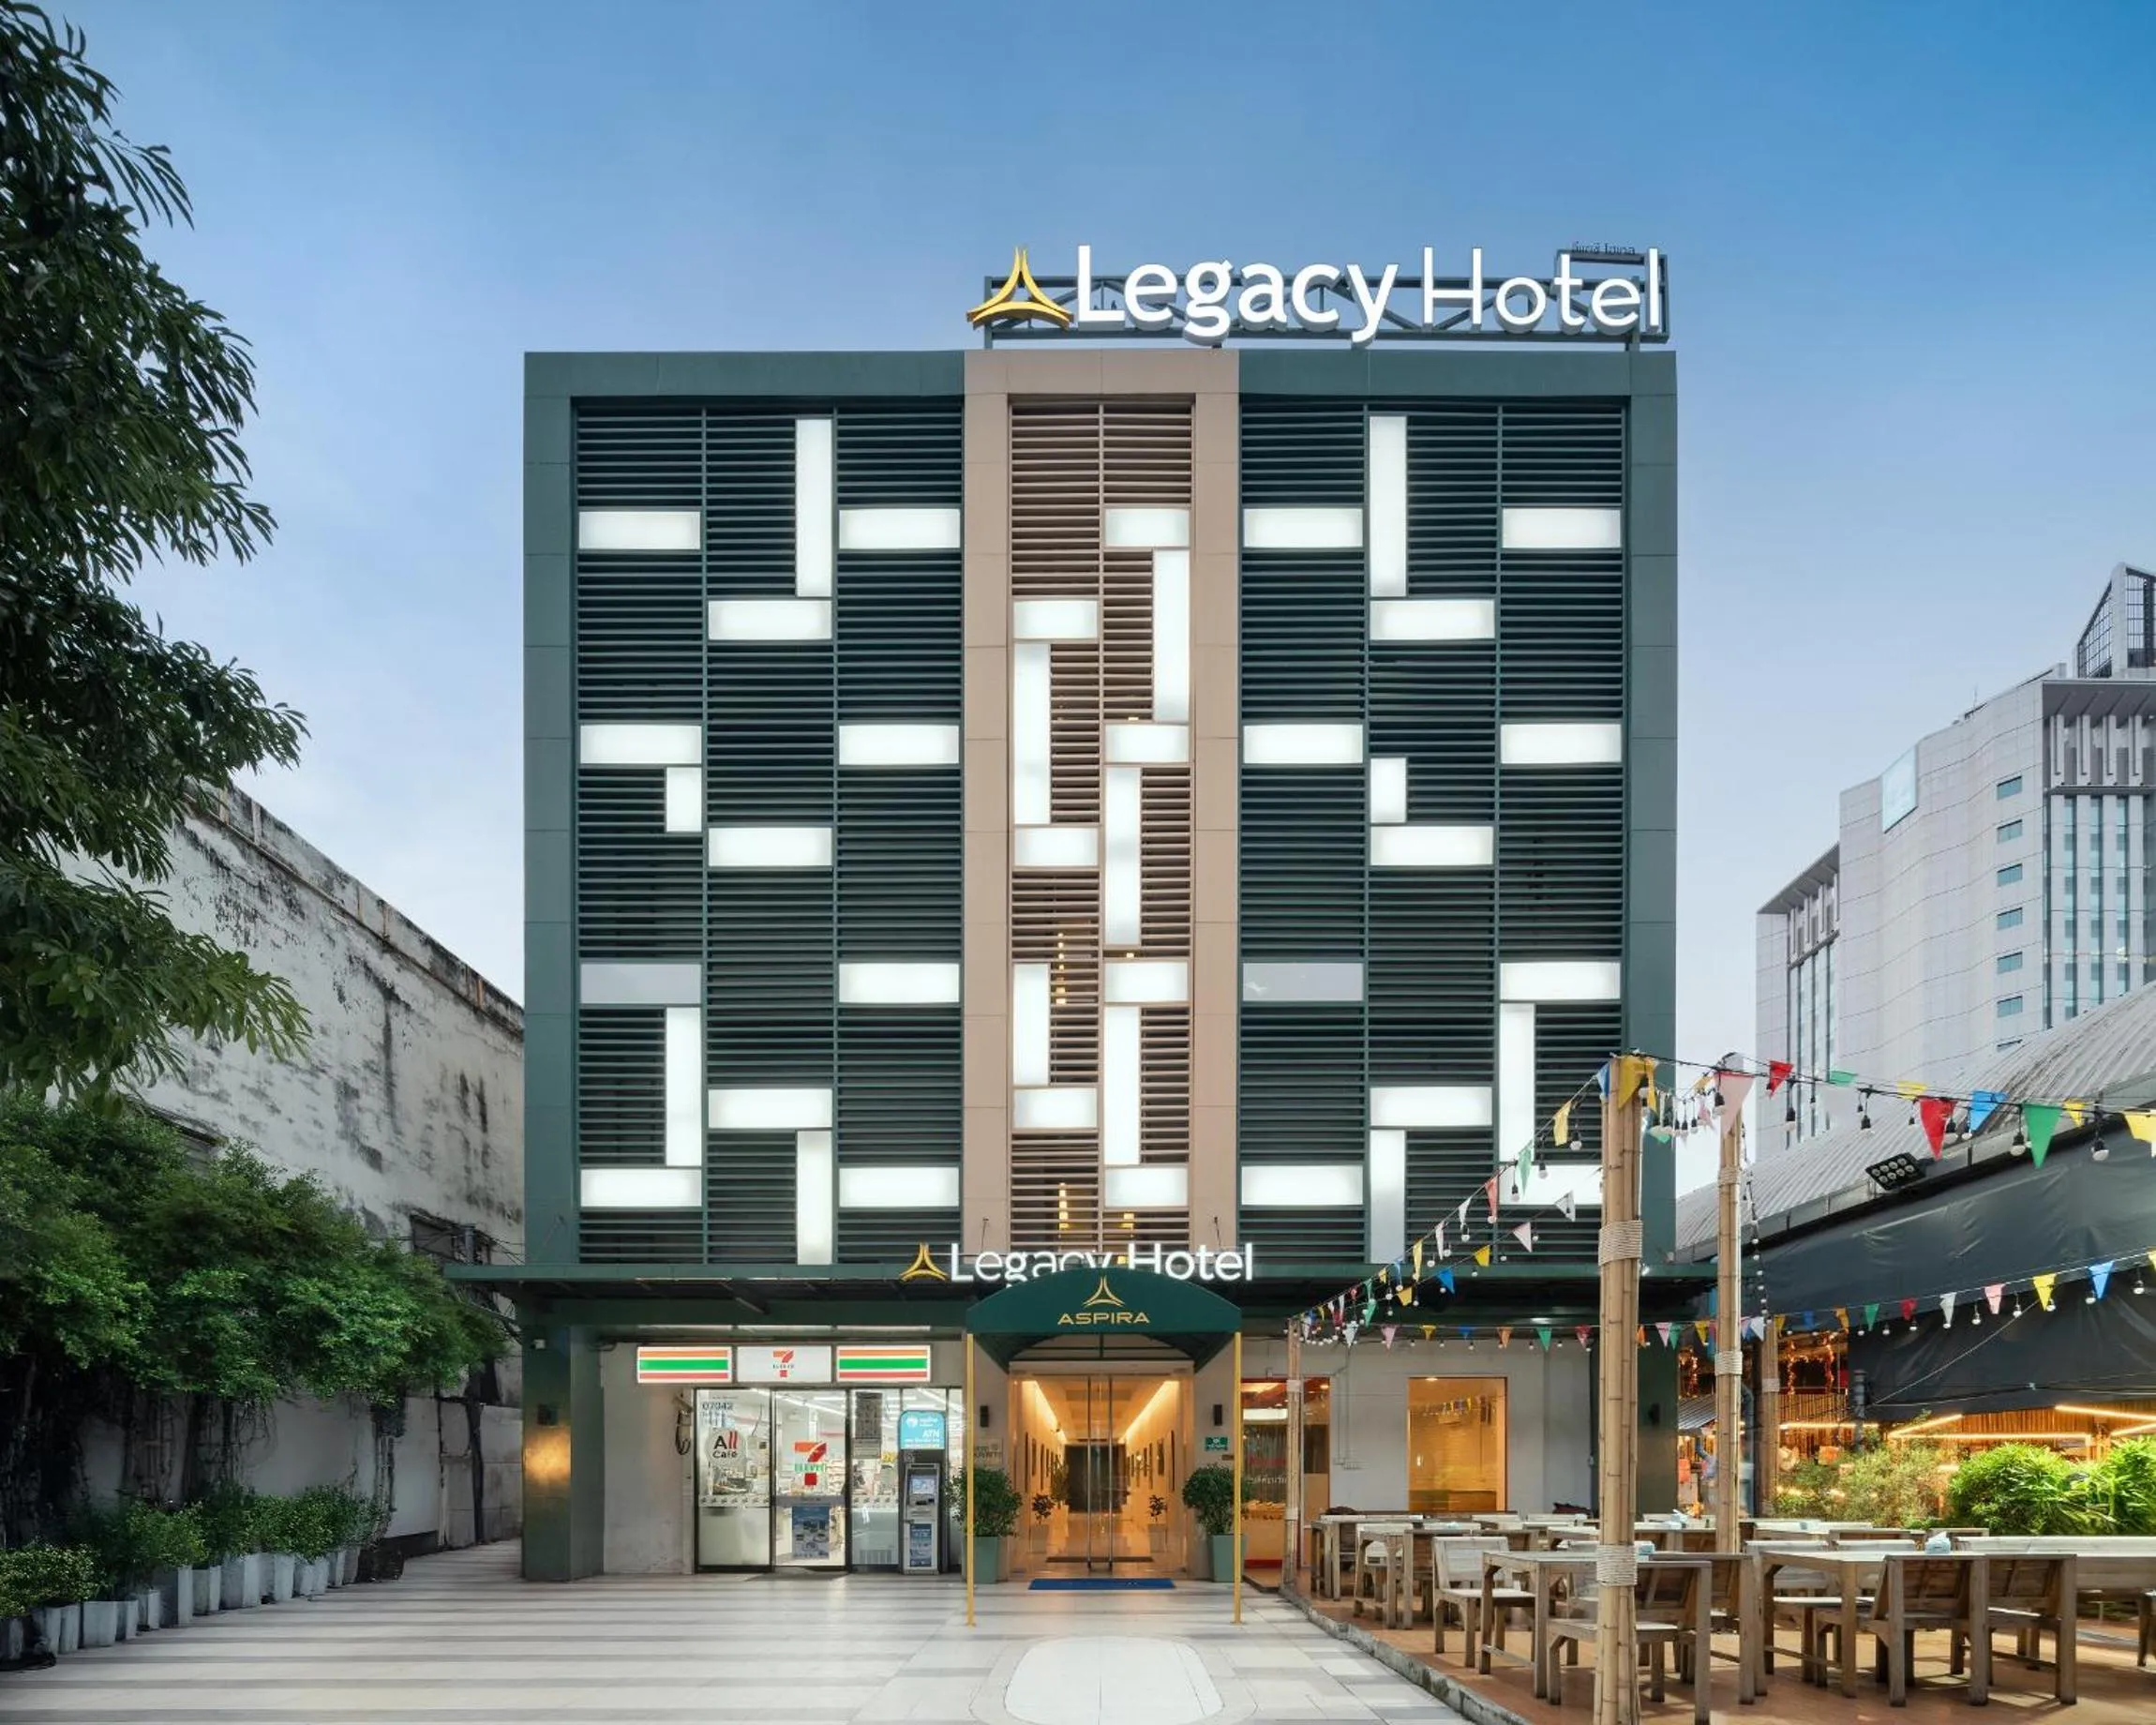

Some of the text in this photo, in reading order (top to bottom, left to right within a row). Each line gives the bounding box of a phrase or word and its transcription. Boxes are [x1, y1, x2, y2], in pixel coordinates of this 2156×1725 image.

[1078, 245, 1660, 347] Legacy Hotel
[1127, 1242, 1254, 1282] Hotel
[1056, 1312, 1150, 1326] ASPIRA
[713, 1431, 738, 1450] All
